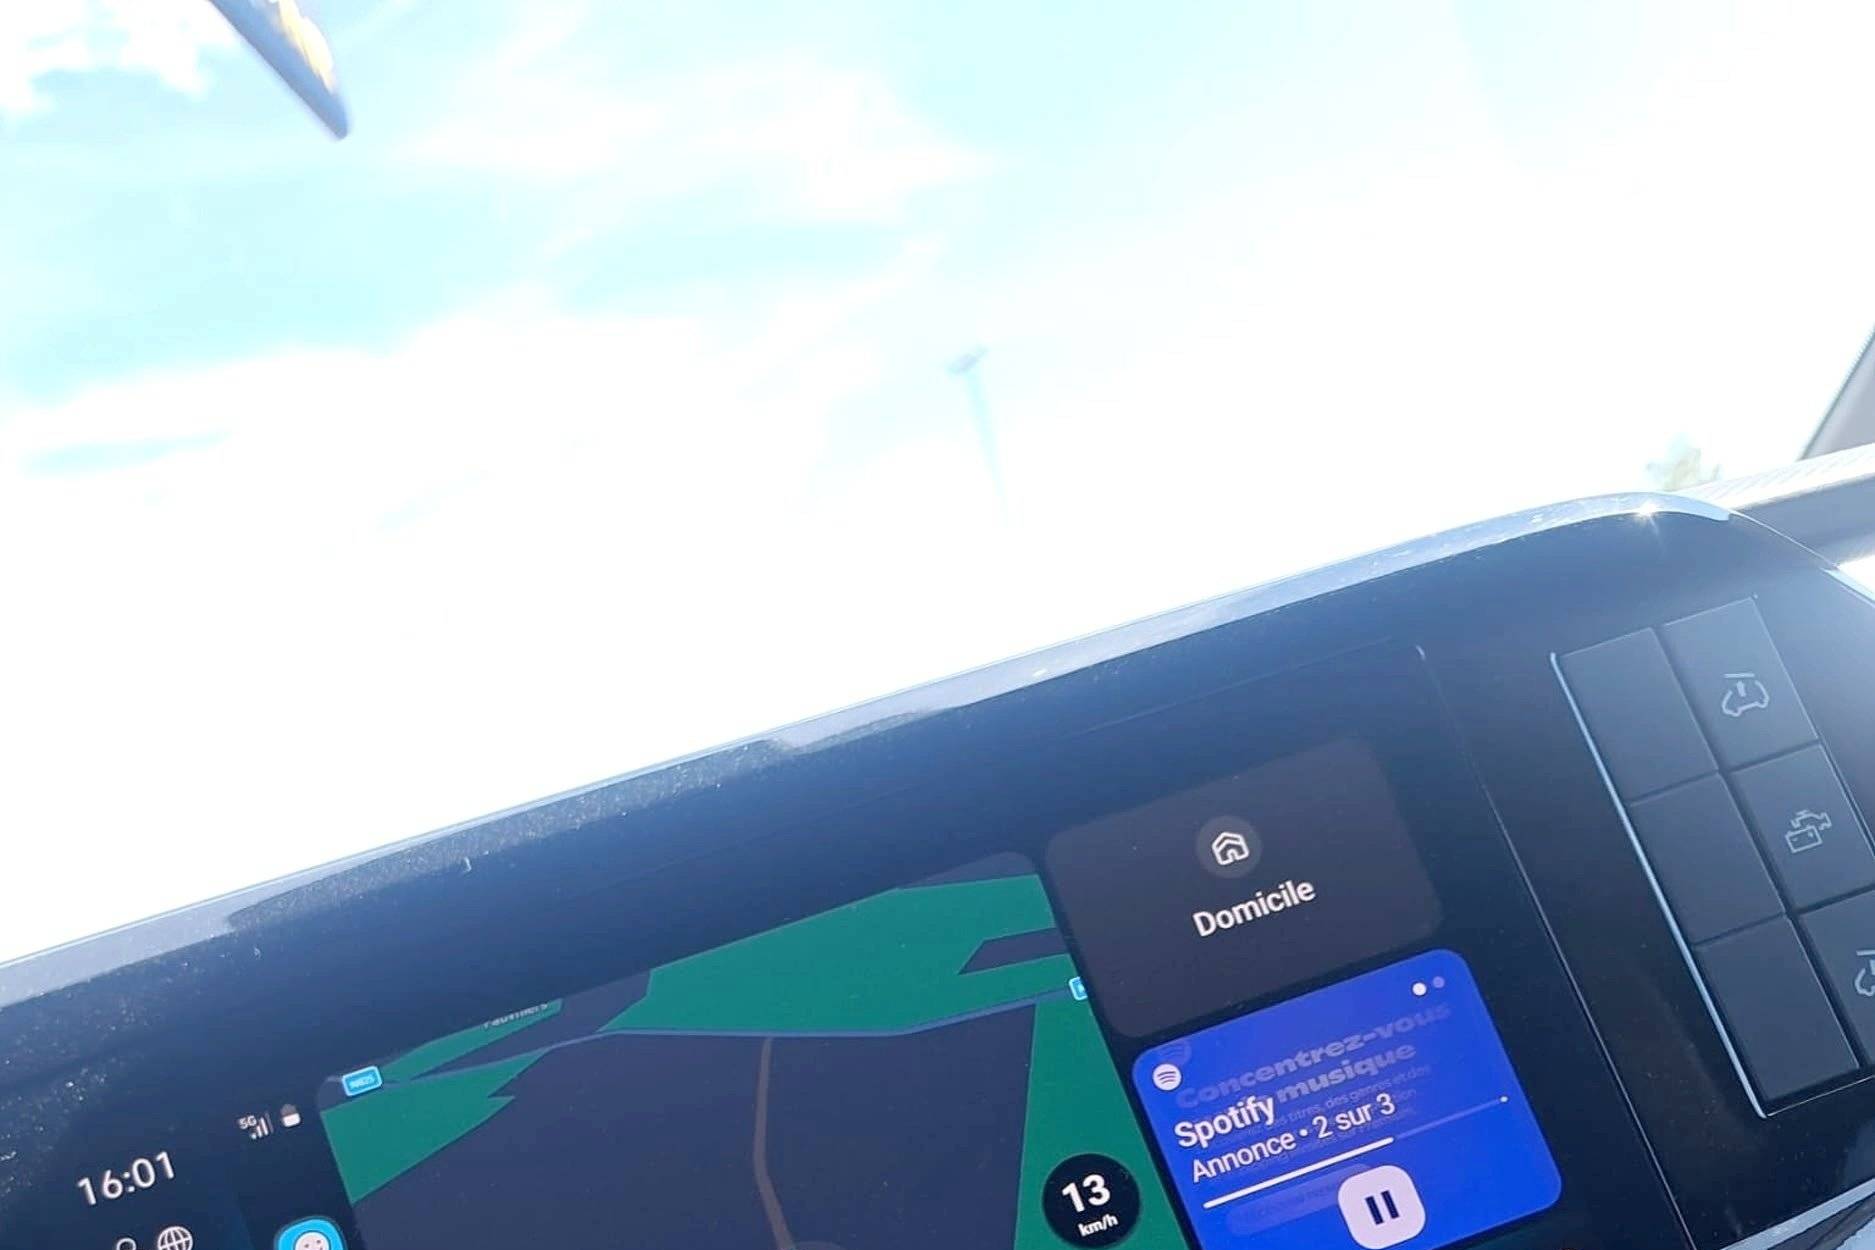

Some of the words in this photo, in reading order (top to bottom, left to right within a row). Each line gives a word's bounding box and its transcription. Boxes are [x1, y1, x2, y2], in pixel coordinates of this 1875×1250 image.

[1192, 879, 1317, 937] Domicile
[1176, 1003, 1452, 1108] Concentrez-vous
[1276, 1043, 1416, 1104] musique
[1173, 1095, 1276, 1149] Spotify
[1192, 1130, 1297, 1183] Annonce
[1312, 1115, 1334, 1140] 2
[1335, 1103, 1373, 1130] sur
[1376, 1092, 1396, 1116] 3
[77, 1151, 176, 1206] 16:01
[1062, 1174, 1112, 1214] 13
[1078, 1213, 1119, 1238] km/h
